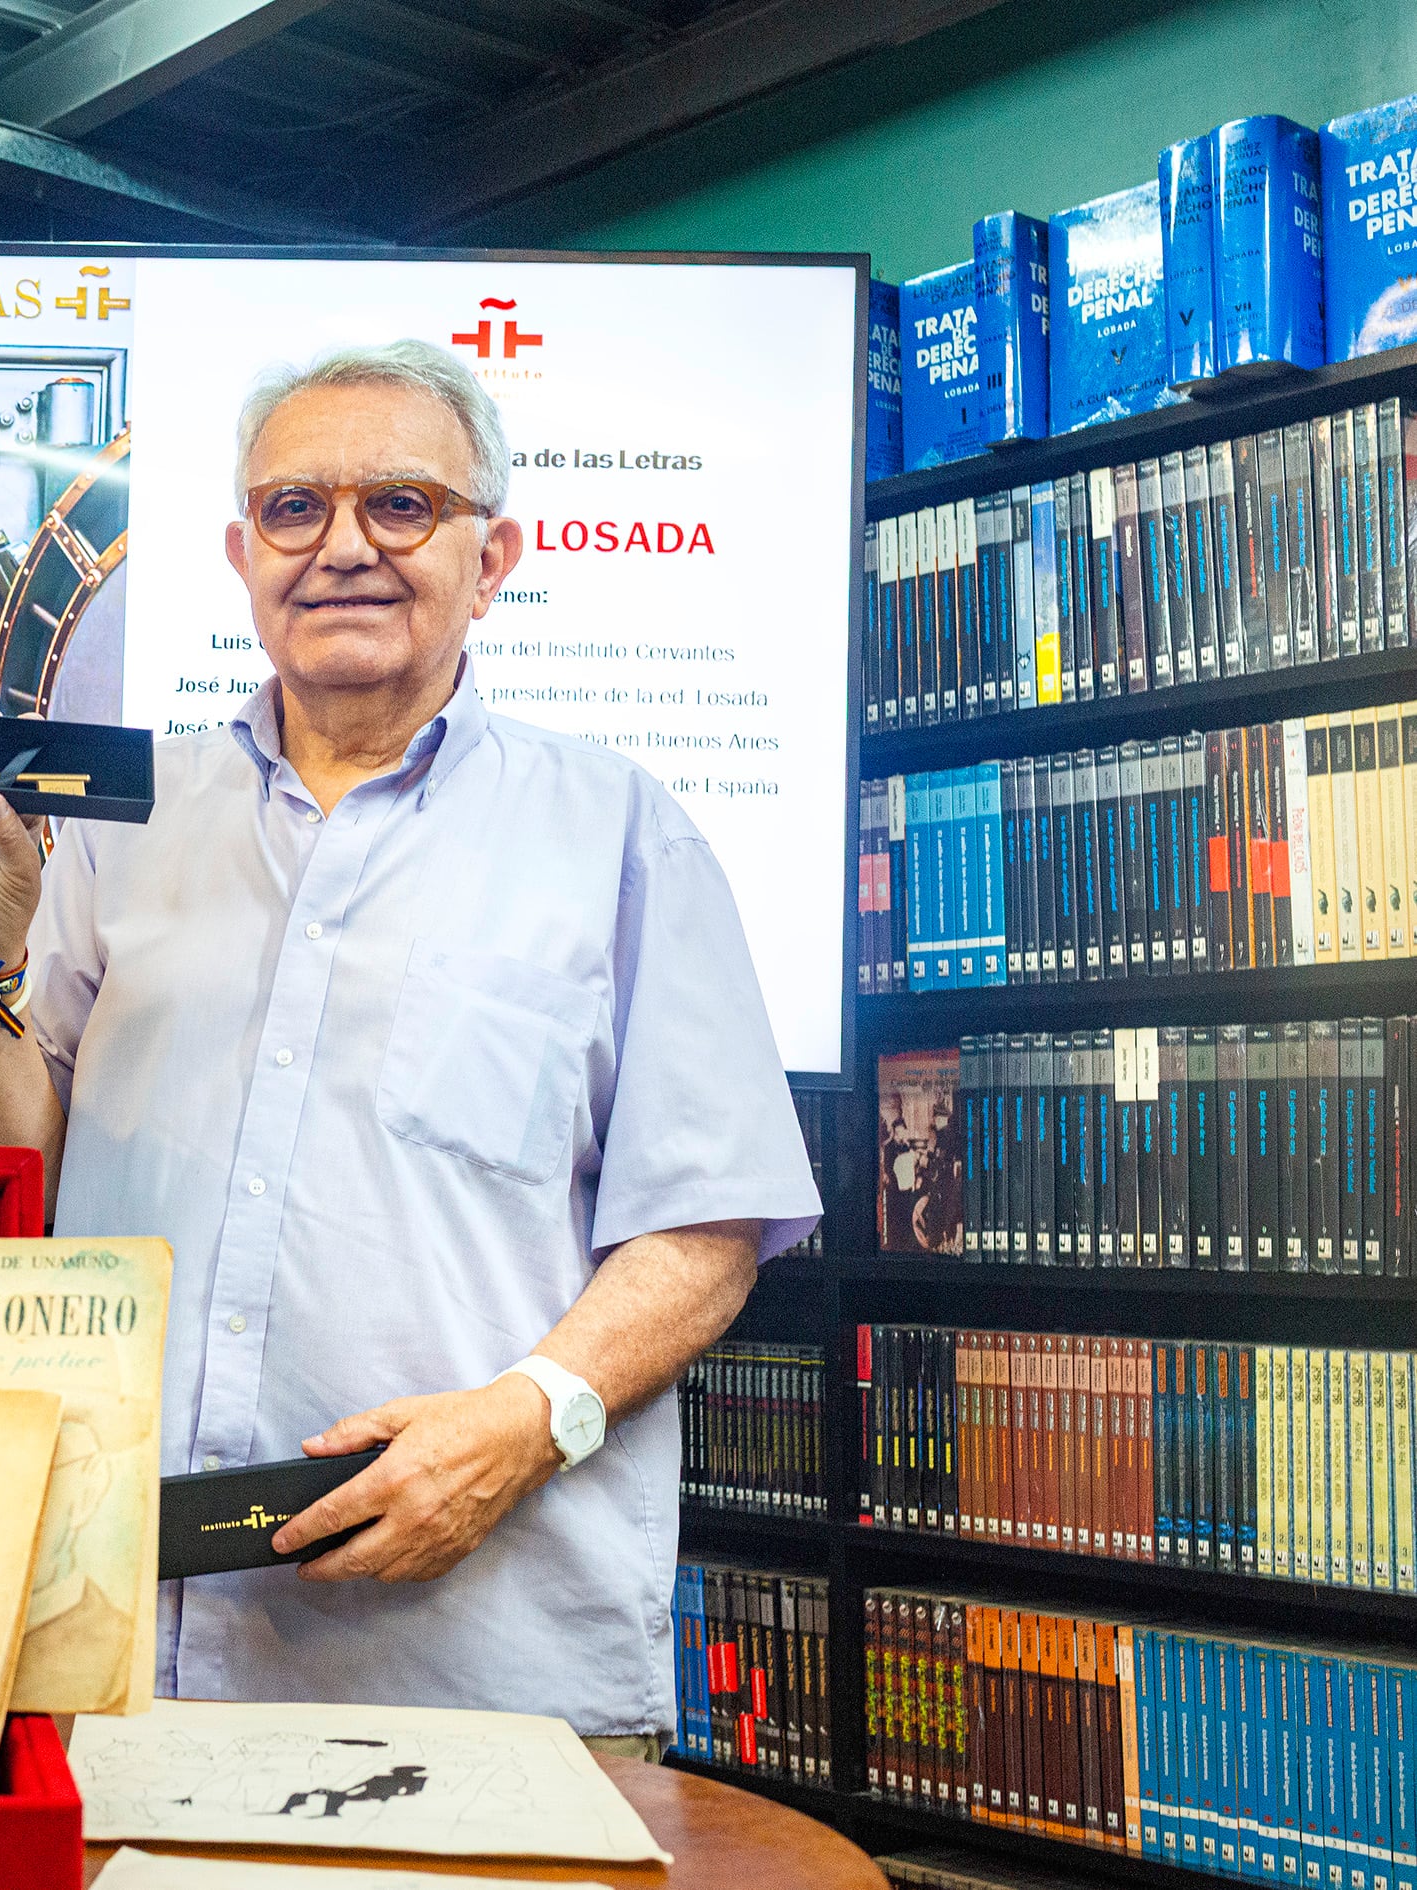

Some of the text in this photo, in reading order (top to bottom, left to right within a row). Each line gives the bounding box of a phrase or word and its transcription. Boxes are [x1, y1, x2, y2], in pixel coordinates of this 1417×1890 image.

[1345, 148, 1417, 187] TRAT
[1348, 188, 1417, 222] DERE
[1366, 206, 1417, 241] PEN
[1081, 287, 1153, 324] PENAL
[1234, 302, 1252, 313] VII
[914, 305, 978, 339] TRATA
[1179, 309, 1194, 327] V
[952, 325, 969, 340] DE
[916, 334, 977, 369] DEREC
[1111, 347, 1127, 365] V
[929, 354, 979, 385] PENA
[987, 372, 1003, 390] III
[534, 449, 566, 469] de
[574, 449, 613, 469] las
[619, 450, 703, 470] Letras
[536, 520, 716, 555] LOSADA
[212, 634, 251, 650] Luis
[511, 641, 735, 662] del Instituto Cervantes
[175, 676, 259, 694] José Jua
[492, 686, 596, 705] presidente
[604, 687, 628, 704] de
[637, 688, 653, 704] la
[696, 688, 768, 707] Losada
[165, 720, 208, 735] José
[616, 731, 779, 751] en Buenos Aires
[672, 777, 779, 798] de España
[1, 1255, 23, 1270] DE
[32, 1255, 119, 1271] UNAMUNO
[200, 1520, 241, 1531] Instituto
